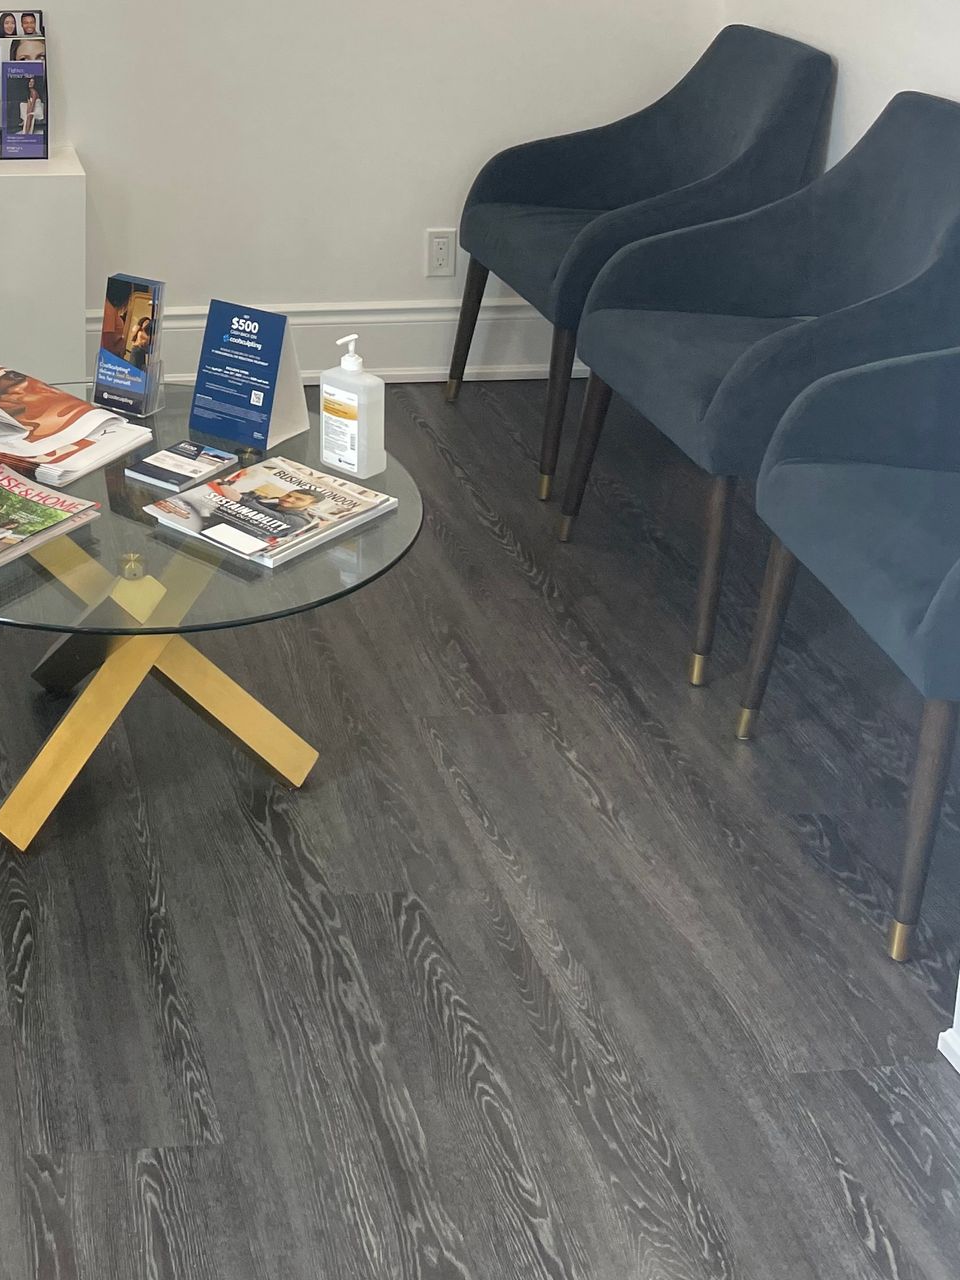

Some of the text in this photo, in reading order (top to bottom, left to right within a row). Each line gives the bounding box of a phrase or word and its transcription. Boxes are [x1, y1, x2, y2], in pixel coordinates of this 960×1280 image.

[231, 317, 259, 333] $500
[18, 484, 34, 497] &
[33, 492, 84, 513] HOME
[320, 488, 361, 508] LONDON
[206, 492, 291, 530] SUSTAINABILITY
